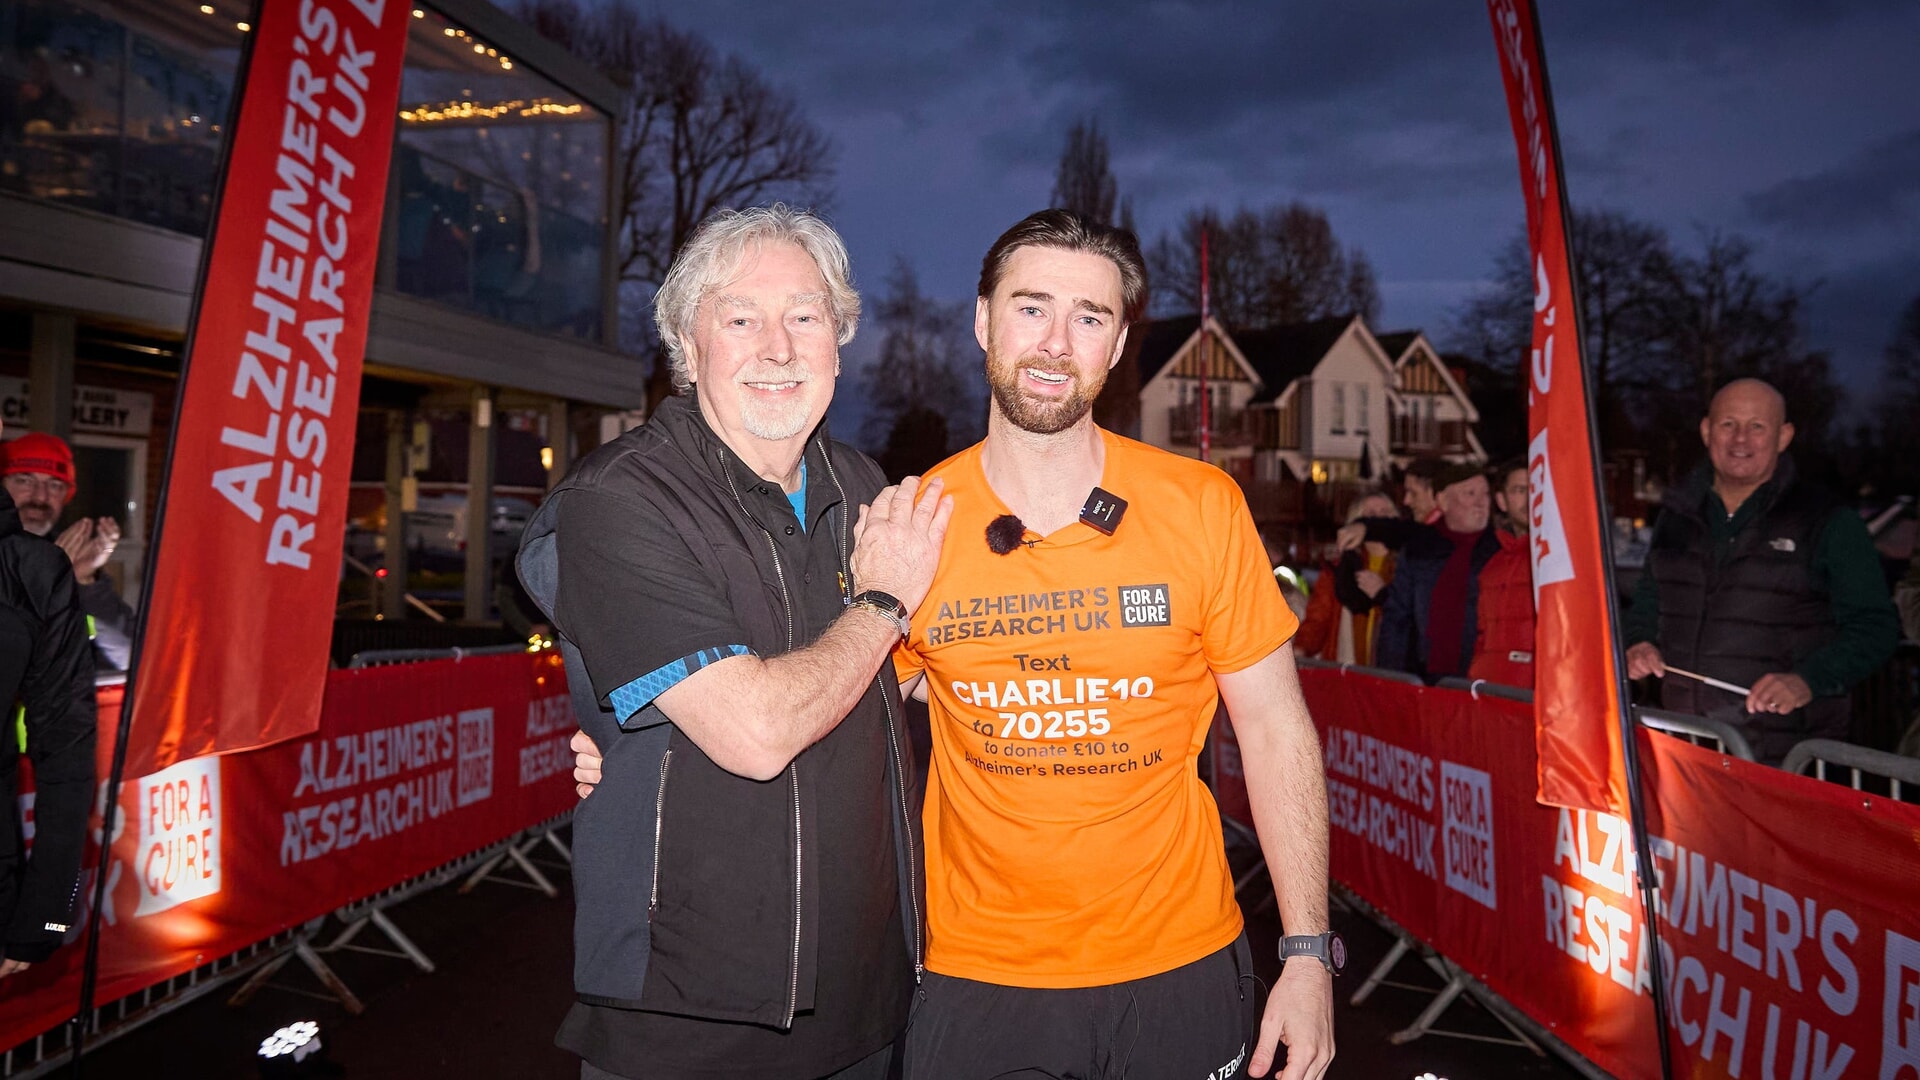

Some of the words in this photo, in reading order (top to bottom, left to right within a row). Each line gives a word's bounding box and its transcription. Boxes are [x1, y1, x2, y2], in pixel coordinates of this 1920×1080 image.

[211, 0, 337, 523] ALZHEIMER'S
[265, 143, 355, 570] RESEARCH
[327, 27, 376, 137] UK
[936, 586, 1109, 622] ALZHEIMER'S
[1122, 588, 1151, 606] FOR
[1154, 587, 1166, 605] A
[1124, 605, 1167, 624] CURE
[927, 614, 1066, 646] RESEARCH
[1074, 610, 1112, 632] UK
[951, 676, 1154, 708] CHARLIE10
[1013, 653, 1072, 672] Text
[972, 719, 995, 738] to
[998, 708, 1111, 740] 70255
[984, 740, 998, 754] to
[1003, 743, 1067, 758] donate
[1073, 742, 1105, 757] £10
[1111, 741, 1130, 755] to
[293, 713, 454, 798] ALZHEIMER'S
[964, 750, 1047, 777] Alzheimer's
[1053, 758, 1138, 776] Research
[1143, 748, 1164, 767] UK
[1326, 726, 1435, 812] ALZHEIMER'S
[148, 780, 190, 836] FOR
[198, 774, 213, 822] A
[281, 776, 424, 867] RESEARCH
[427, 768, 455, 819] UK
[1327, 778, 1408, 862] ESEARCH
[1411, 815, 1438, 881] UK
[1445, 775, 1472, 824] FOR
[1476, 784, 1489, 834] A
[144, 828, 213, 897] CURE
[1449, 827, 1491, 891] CURE
